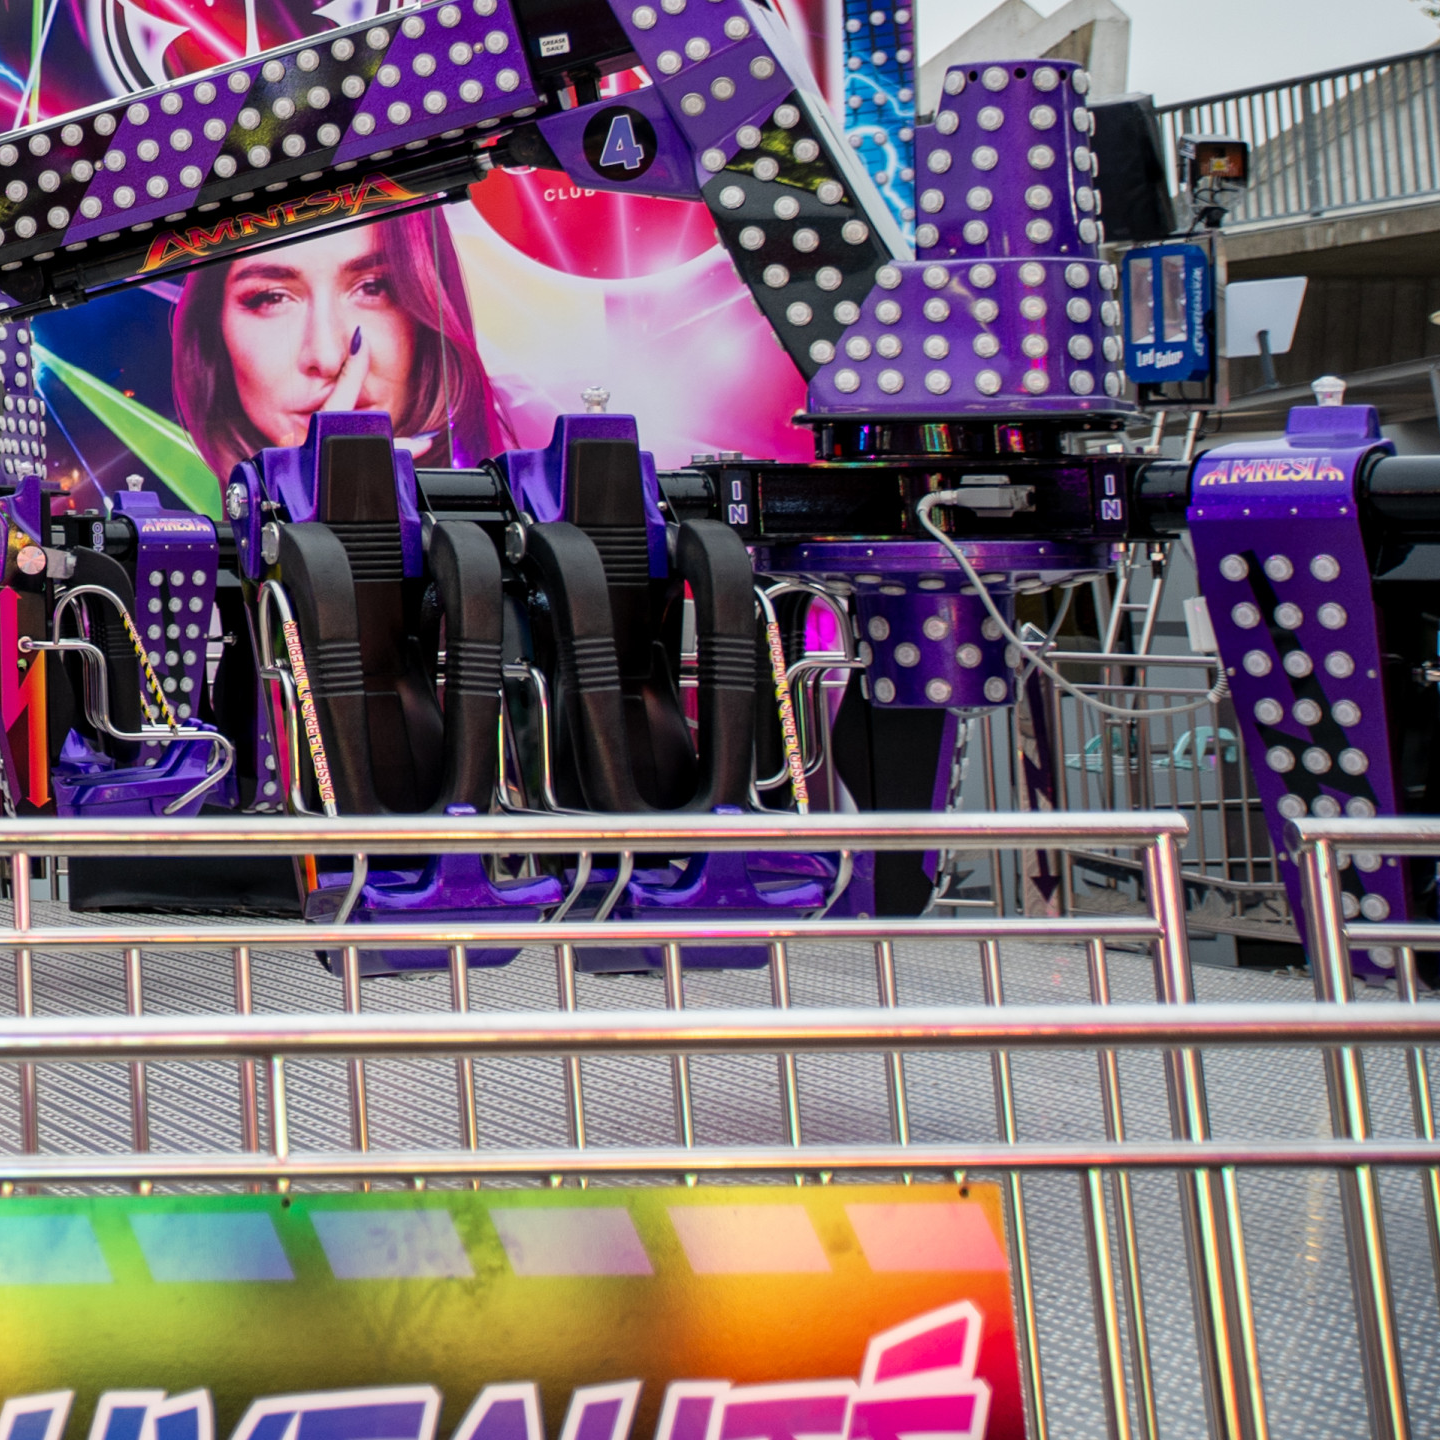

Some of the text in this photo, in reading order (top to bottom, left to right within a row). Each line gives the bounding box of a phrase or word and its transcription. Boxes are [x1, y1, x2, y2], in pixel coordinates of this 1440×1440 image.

[542, 38, 566, 47] GREASE
[546, 45, 564, 53] DAILY
[599, 114, 644, 169] 4
[137, 172, 424, 273] AMNESIA
[1200, 457, 1345, 486] AMNESIA
[728, 480, 748, 524] IN
[1101, 474, 1122, 520] IN
[300, 702, 320, 737] BRAS
[308, 735, 324, 754] LE
[312, 753, 334, 801] PASSER
[789, 753, 807, 799] PASSER
